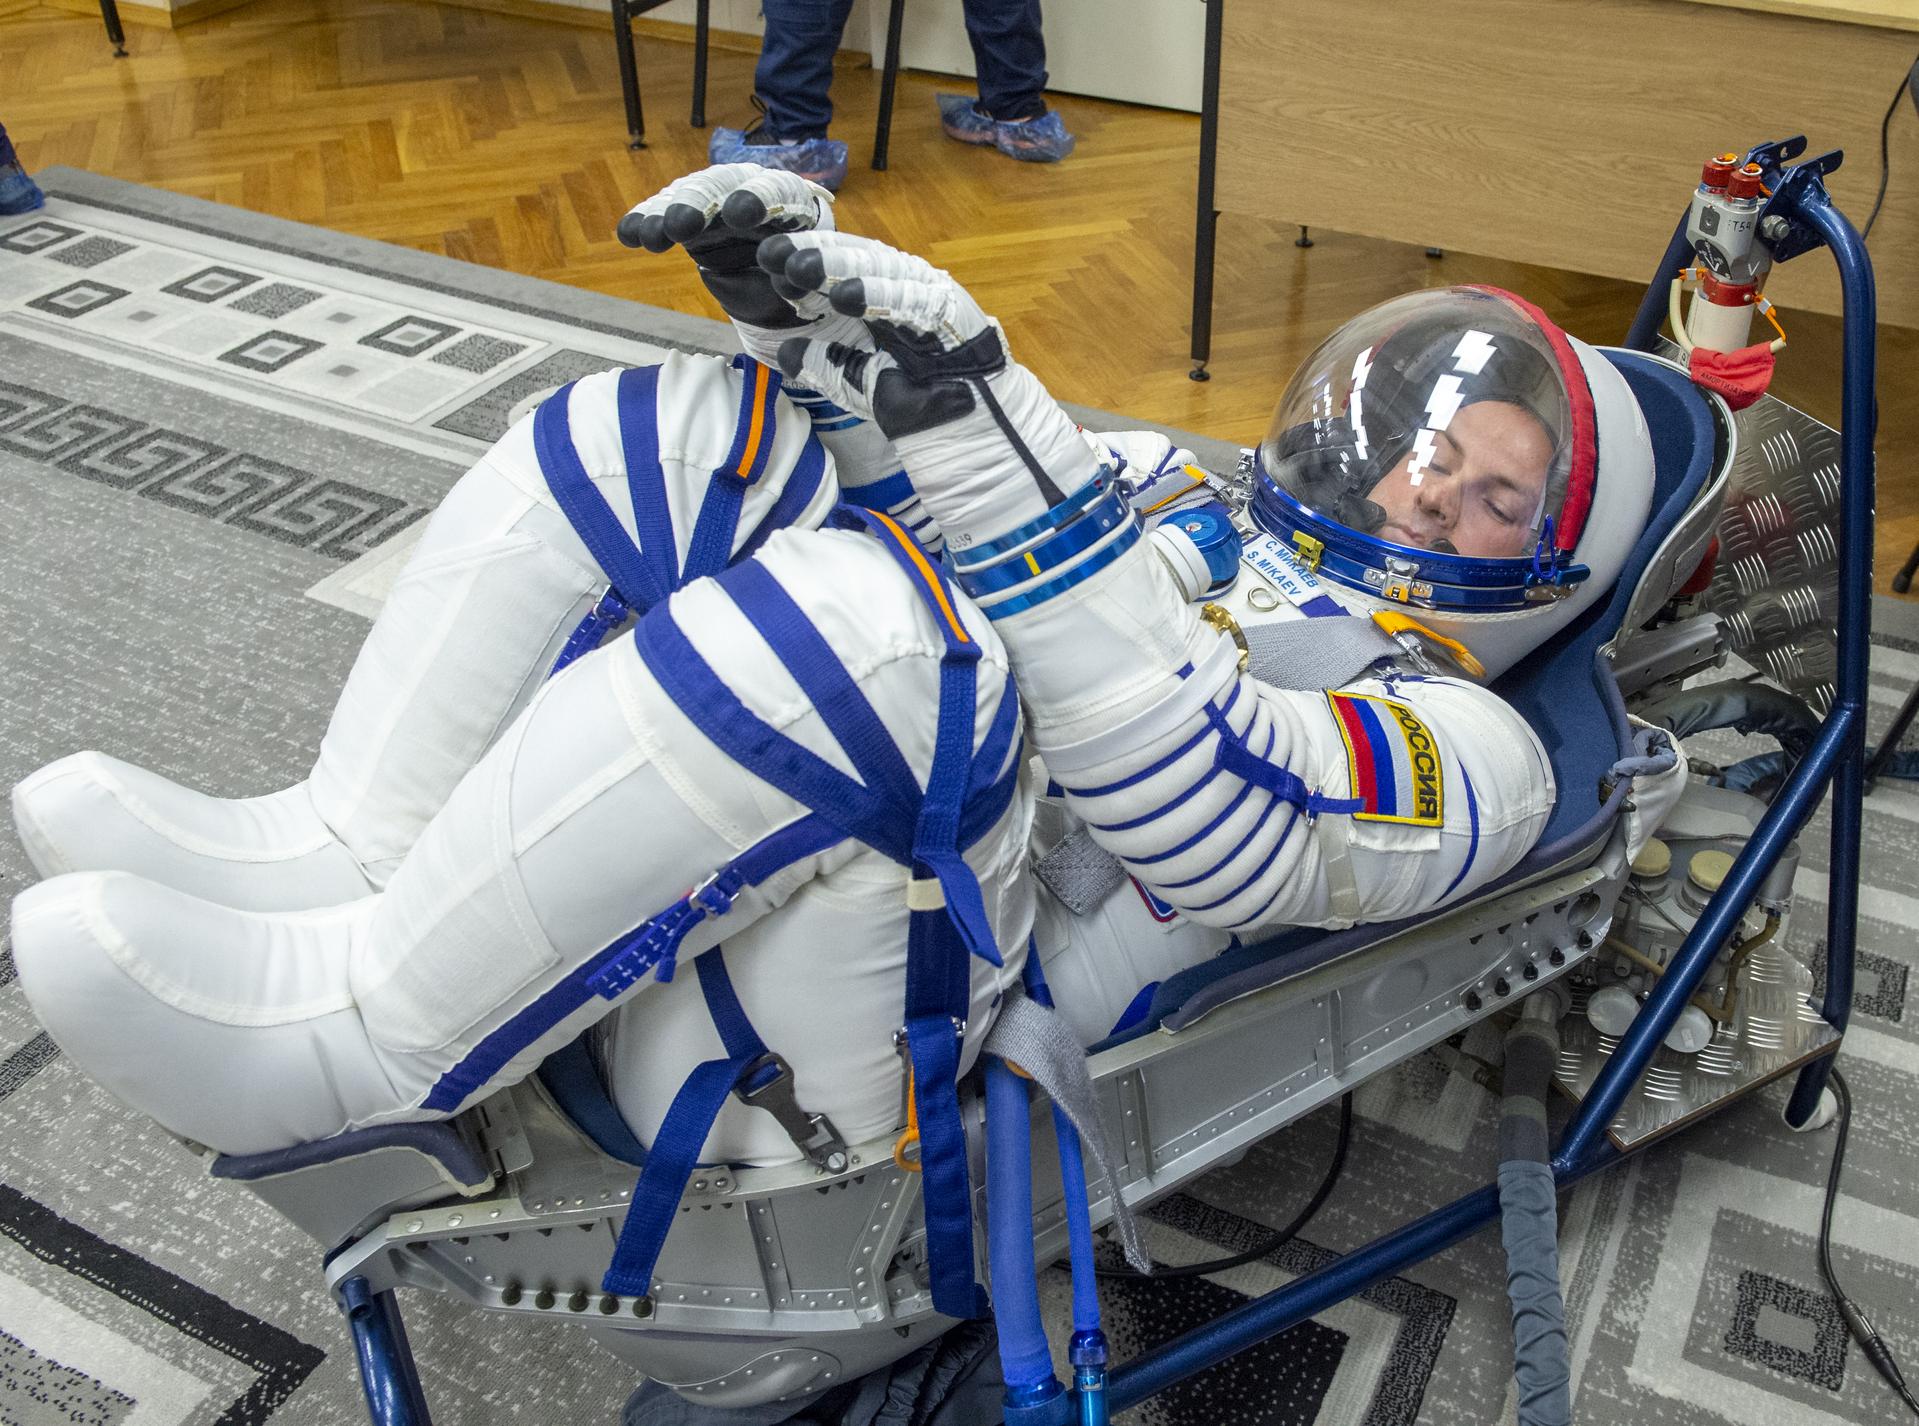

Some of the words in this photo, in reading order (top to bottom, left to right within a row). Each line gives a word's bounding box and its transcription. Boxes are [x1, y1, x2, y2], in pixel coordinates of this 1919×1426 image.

[1247, 551, 1259, 562] S.
[1256, 558, 1302, 595] MIKAEV
[1389, 704, 1438, 819] РОССИЯ
